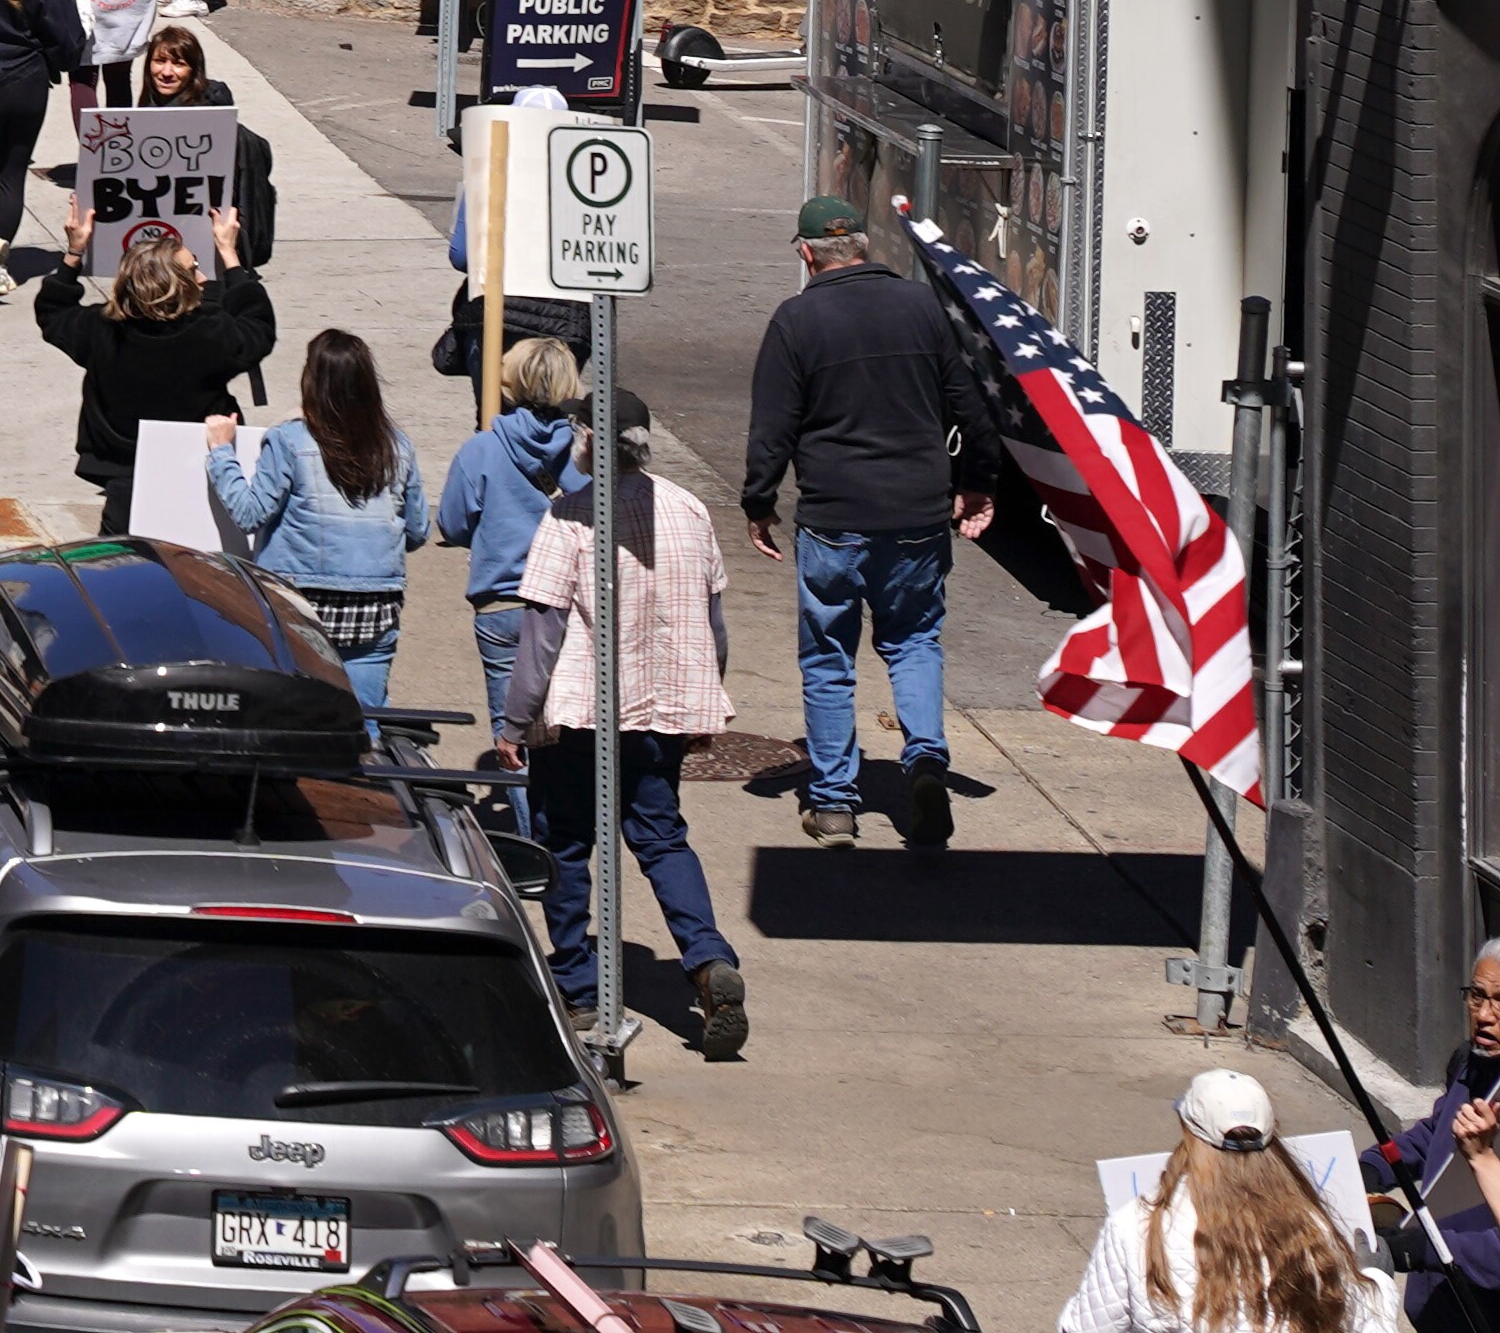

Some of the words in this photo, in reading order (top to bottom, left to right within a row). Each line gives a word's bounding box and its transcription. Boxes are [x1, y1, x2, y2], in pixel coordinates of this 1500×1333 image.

[505, 22, 612, 45] PARKING
[590, 152, 607, 194] P
[95, 175, 225, 220] BYE!
[582, 214, 617, 236] PAY
[562, 239, 639, 265] PARKING
[168, 692, 240, 712] THULE
[248, 1135, 325, 1168] Jeep
[222, 1212, 269, 1246] GRX
[293, 1215, 339, 1249] 418
[243, 1250, 320, 1267] ROSEVILLE
